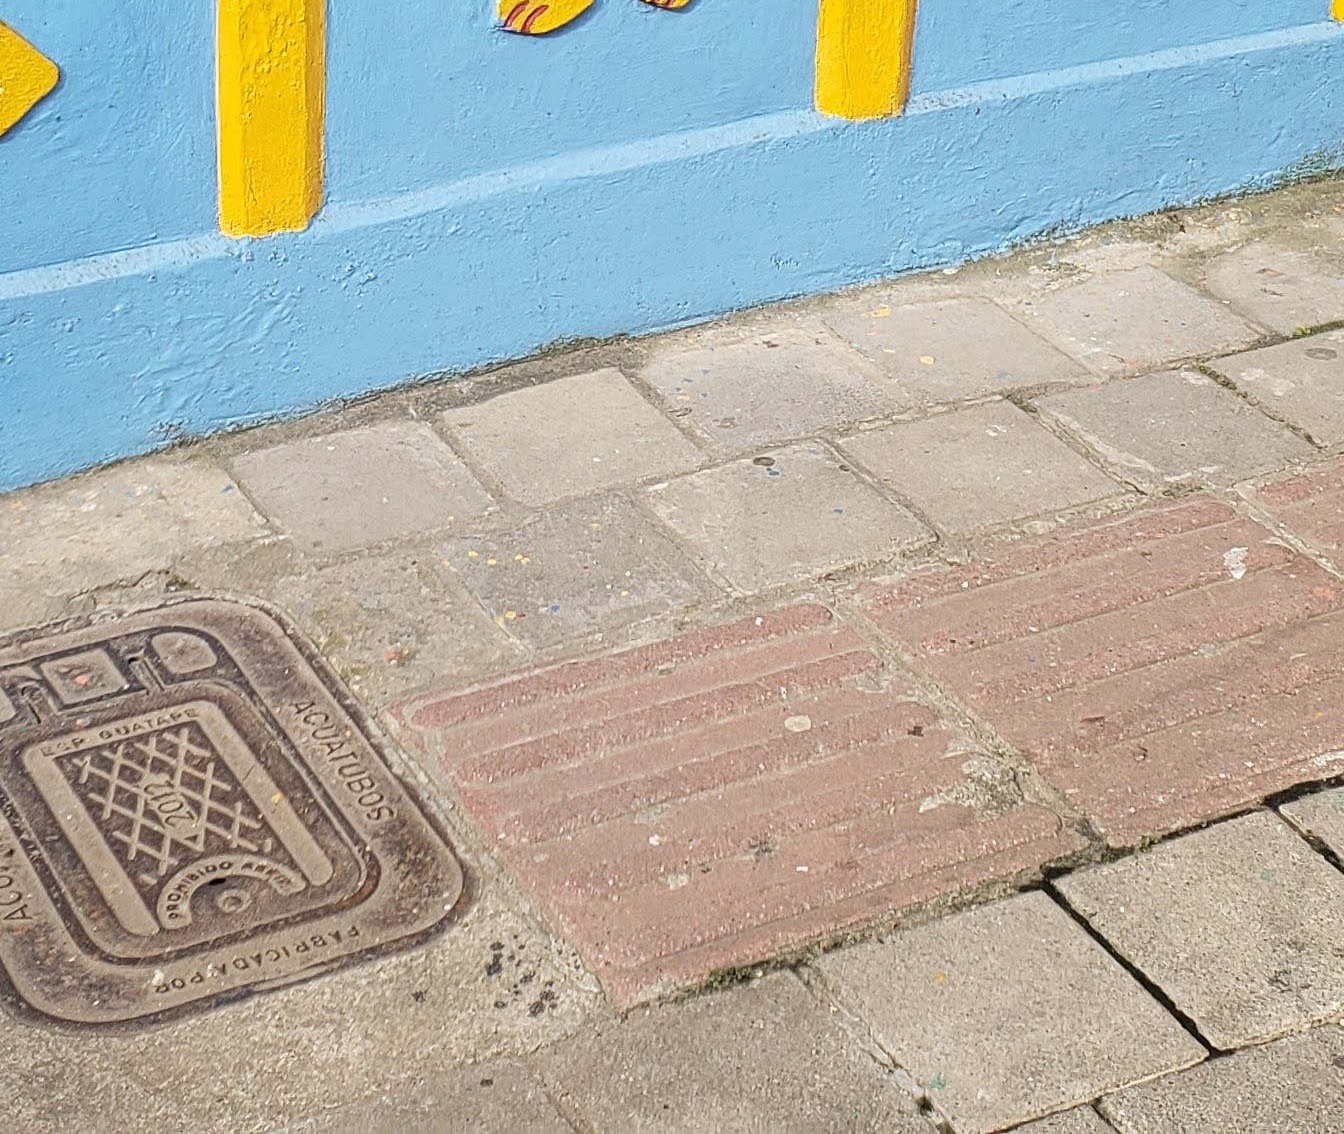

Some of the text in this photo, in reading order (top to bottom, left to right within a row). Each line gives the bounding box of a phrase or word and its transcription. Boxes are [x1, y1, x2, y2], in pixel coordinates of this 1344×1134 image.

[289, 700, 394, 820] ACUATUBOS
[144, 780, 196, 829] 2012
[153, 925, 360, 995] FABRICADA POR
